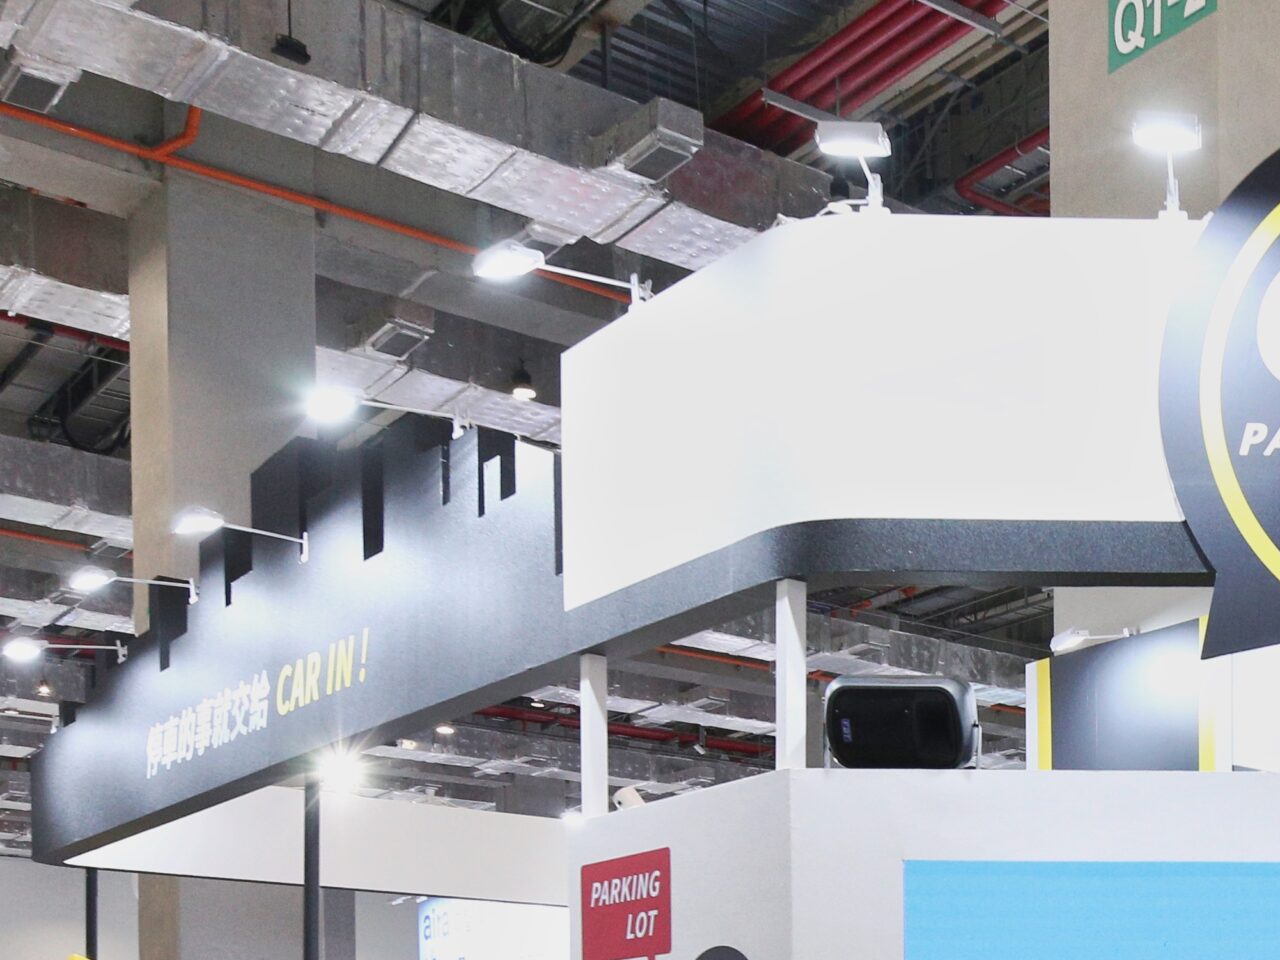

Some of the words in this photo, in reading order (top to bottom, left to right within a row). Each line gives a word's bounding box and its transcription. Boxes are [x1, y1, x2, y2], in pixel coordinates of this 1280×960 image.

[276, 651, 321, 716] CAR
[590, 870, 661, 908] PARKING
[626, 909, 659, 940] LOT
